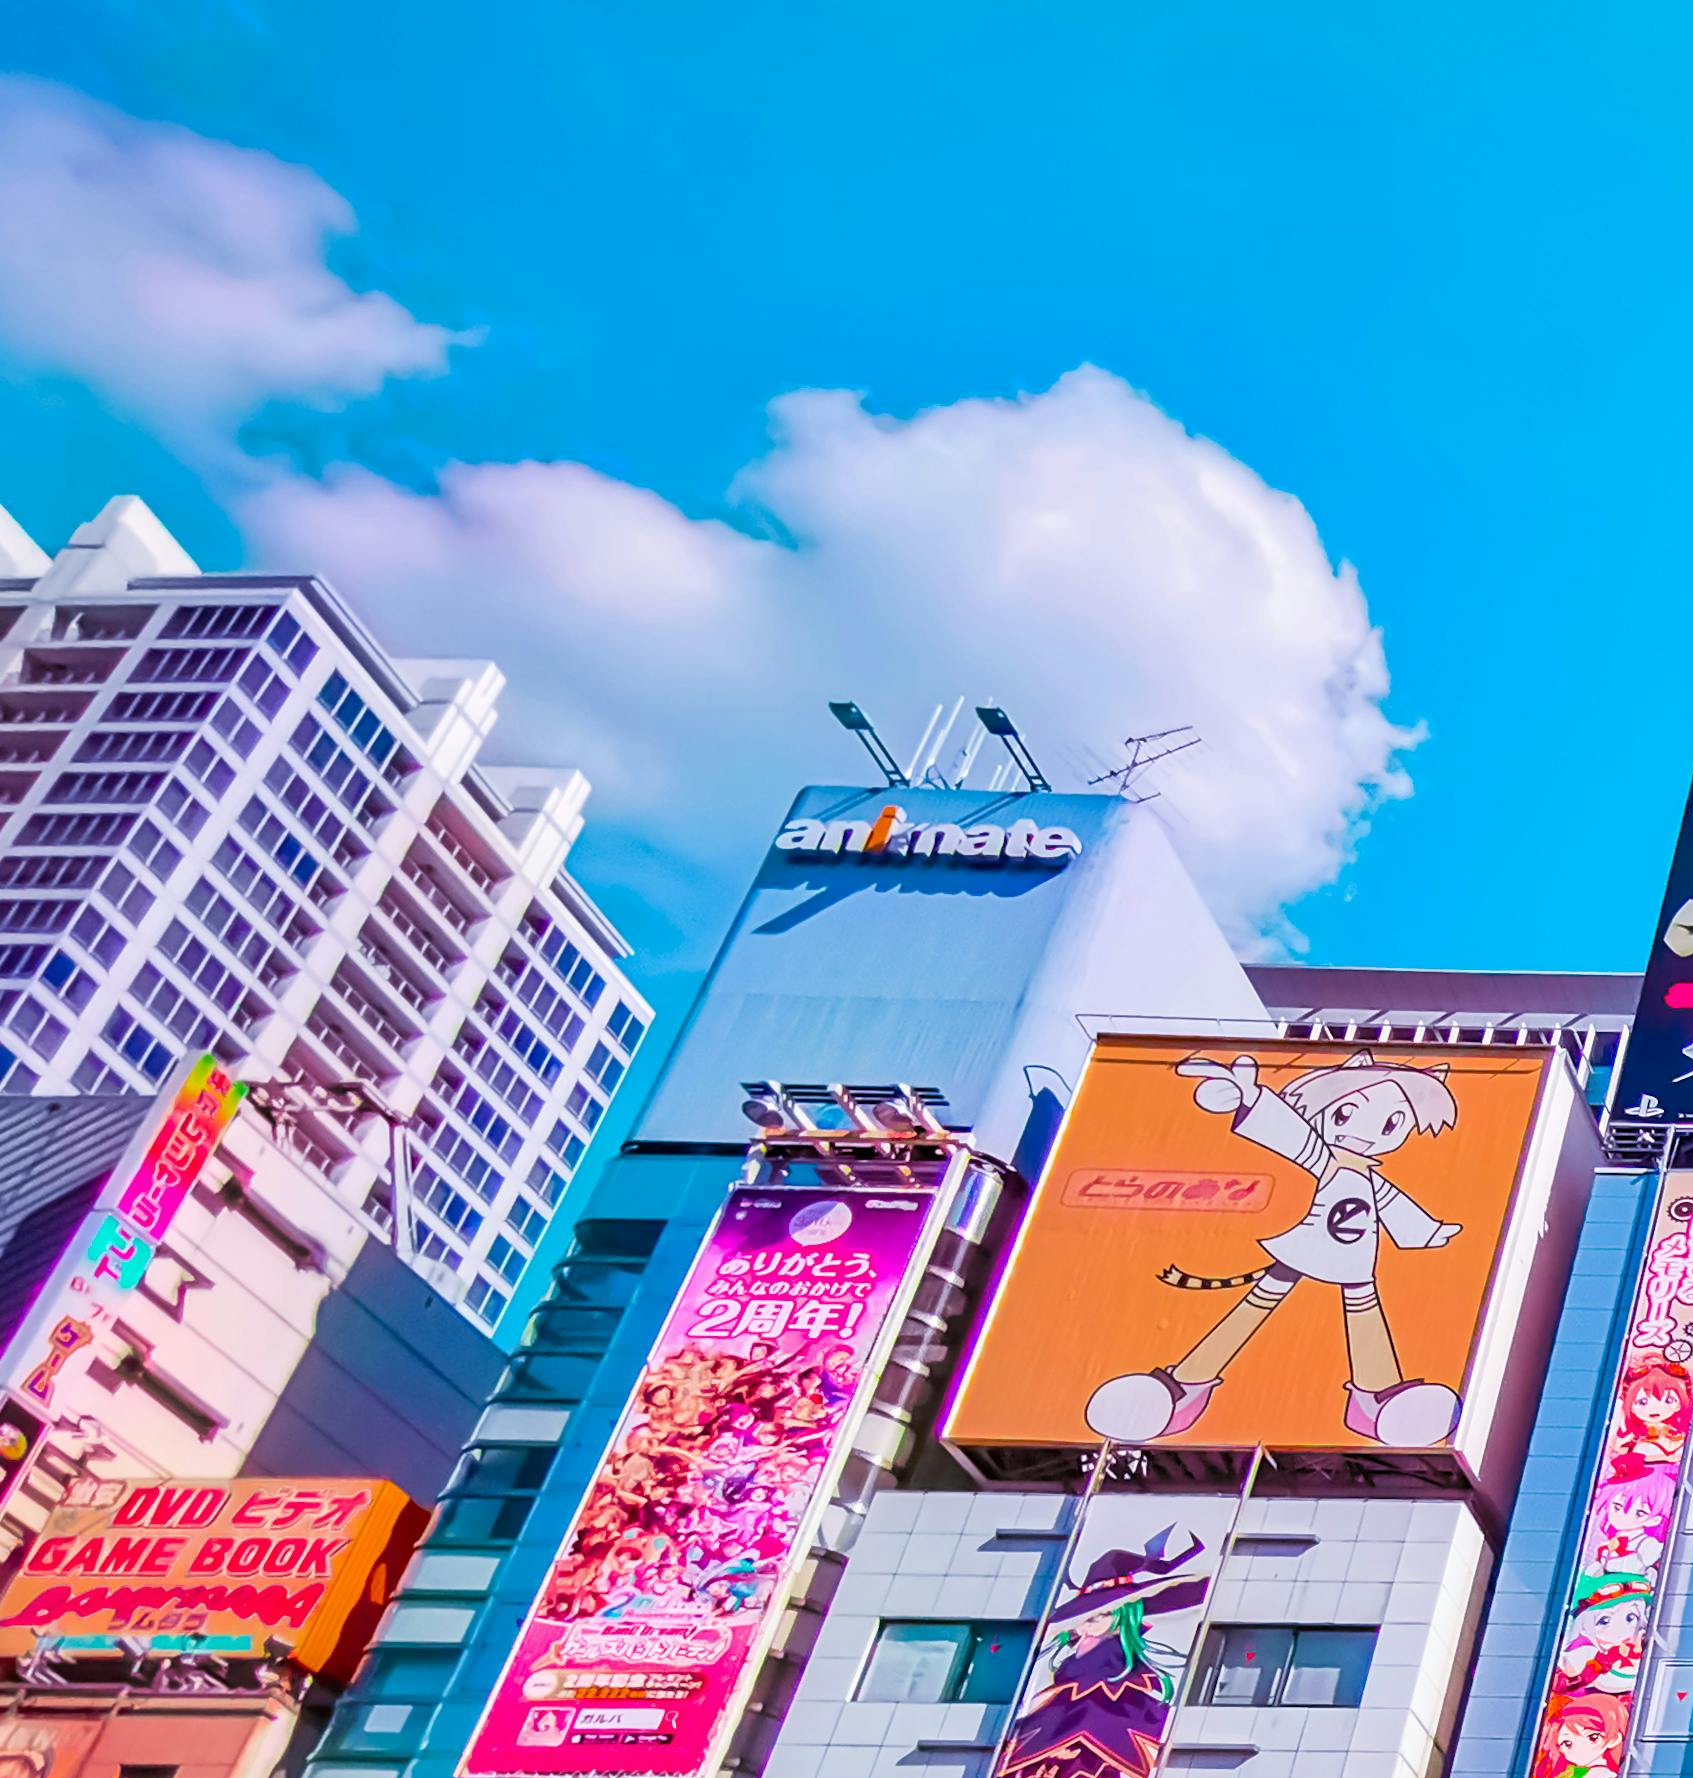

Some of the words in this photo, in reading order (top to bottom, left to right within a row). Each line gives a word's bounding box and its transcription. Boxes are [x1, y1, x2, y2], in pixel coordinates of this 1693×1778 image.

[775, 805, 1082, 859] animate
[112, 1486, 230, 1530] DVD
[230, 1489, 375, 1530] ビデオ
[23, 1536, 191, 1578] GAME
[188, 1536, 349, 1578] BOOK
